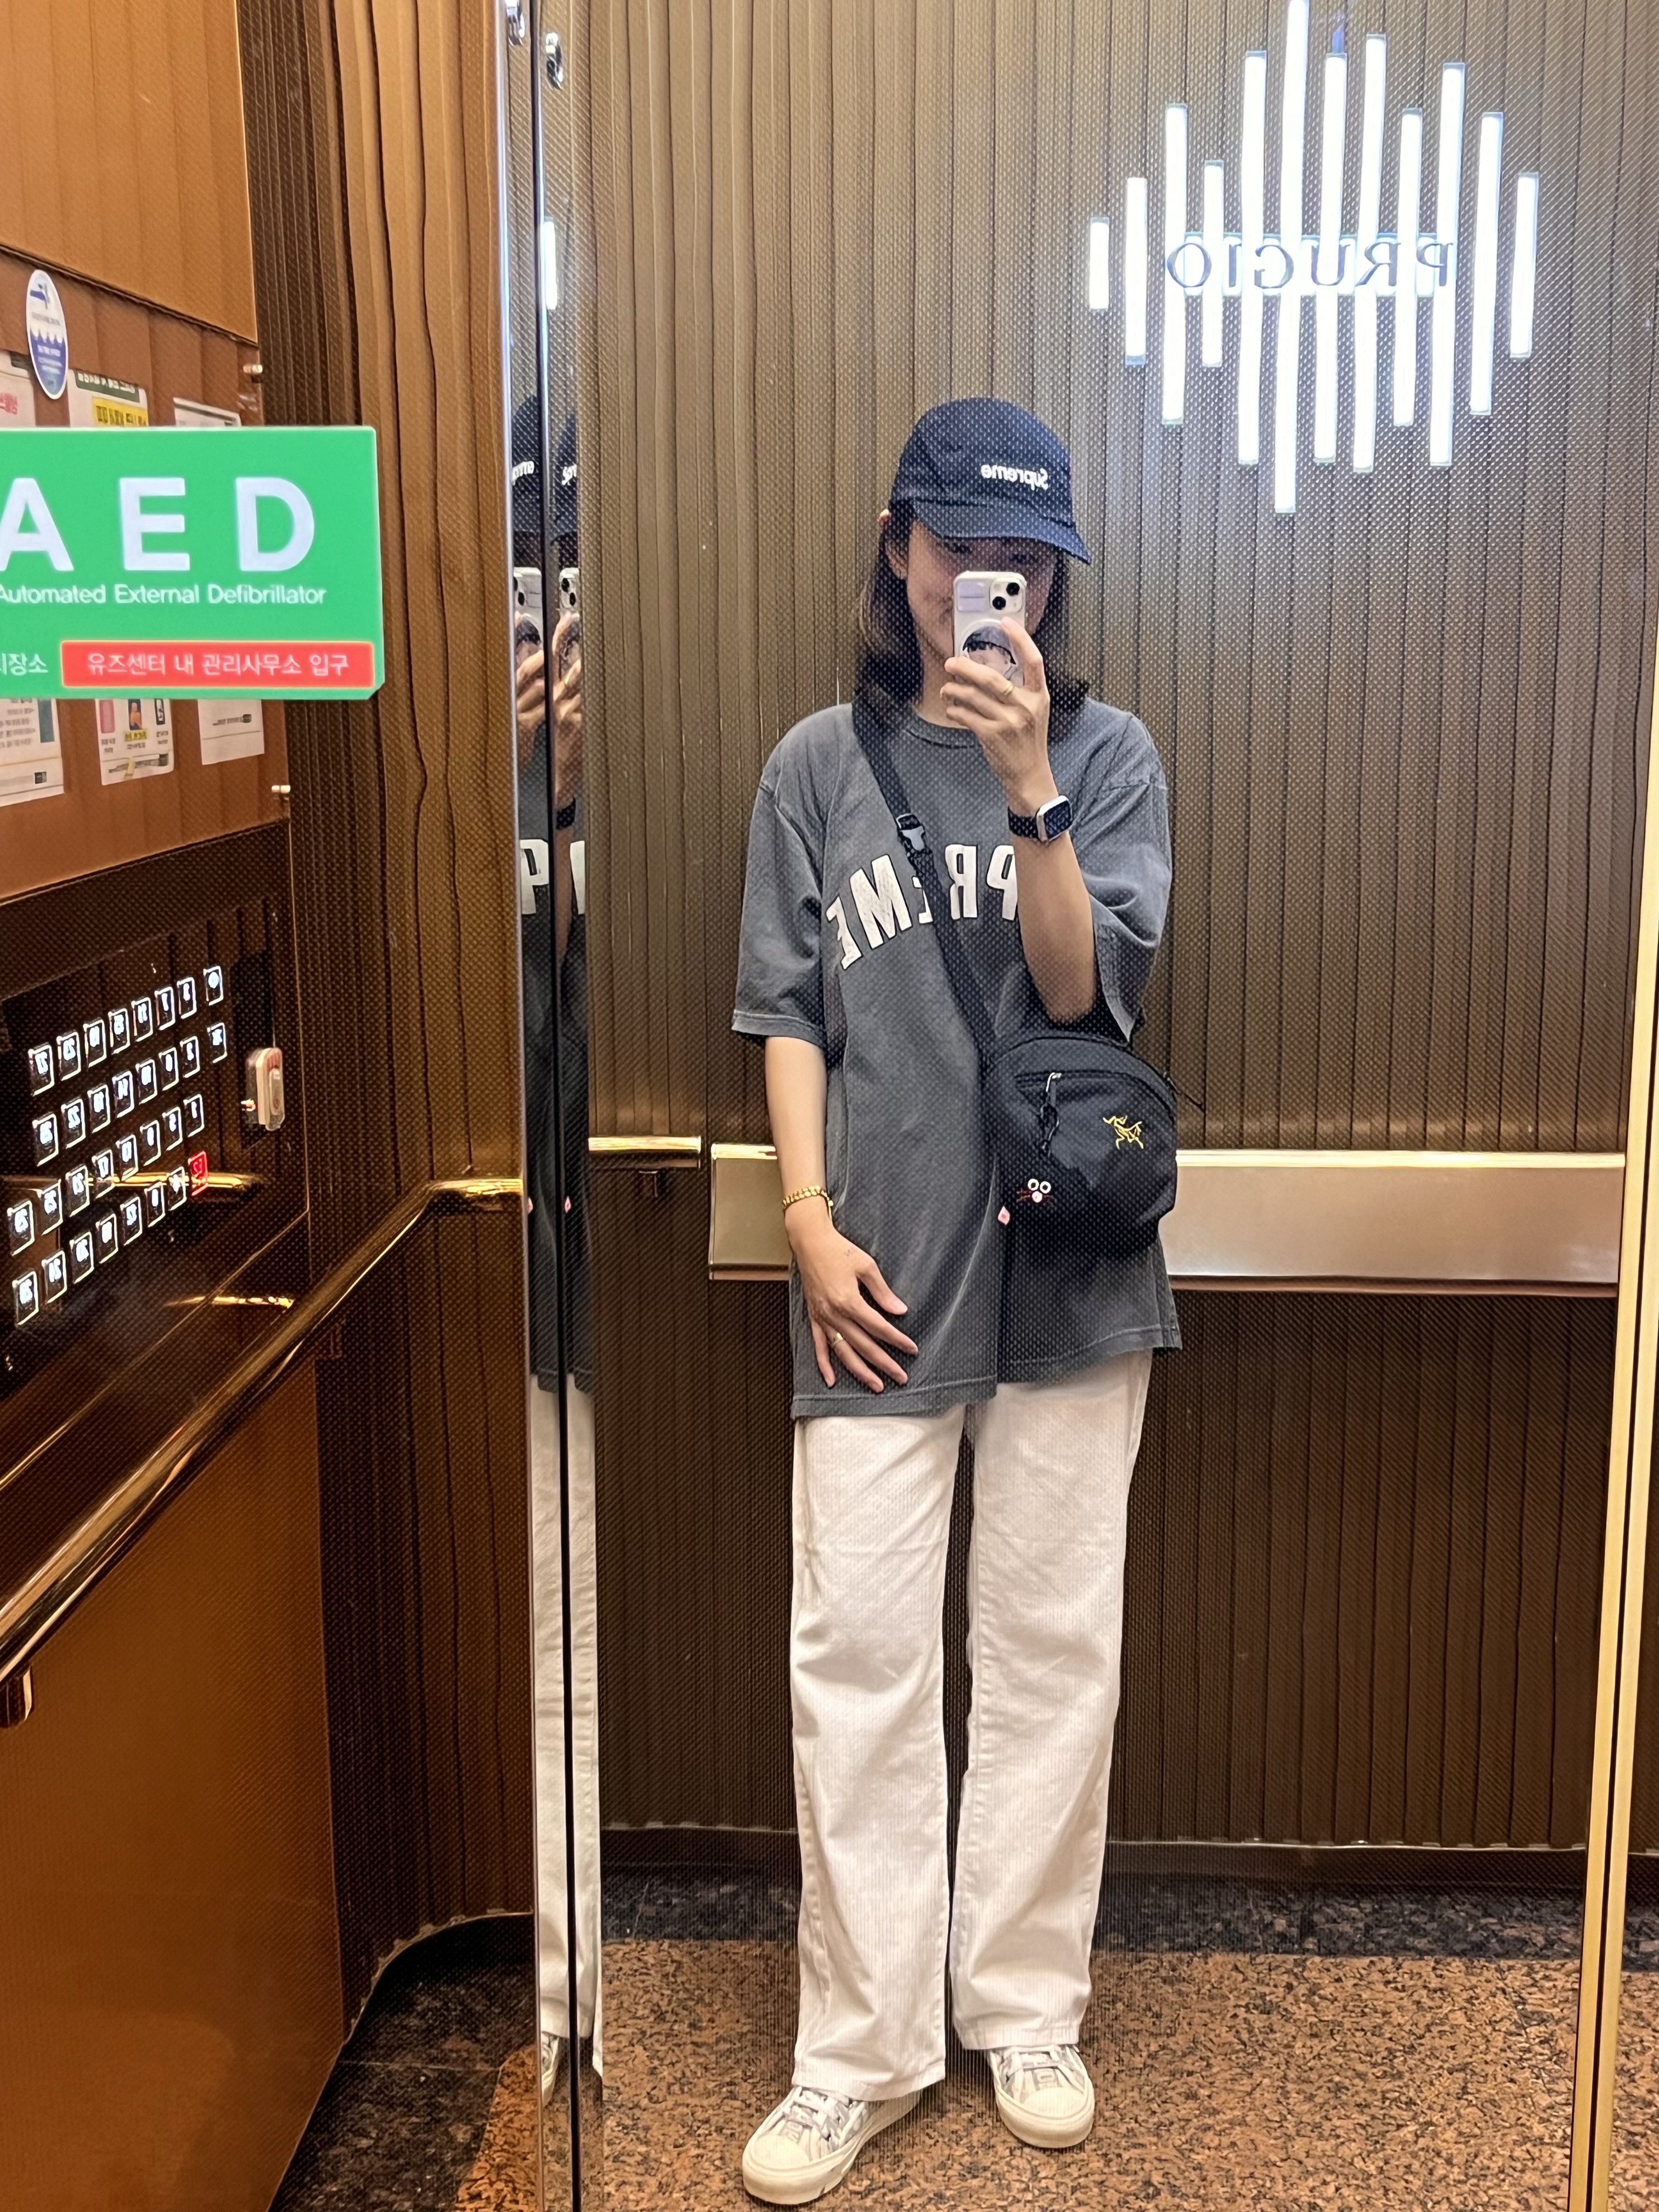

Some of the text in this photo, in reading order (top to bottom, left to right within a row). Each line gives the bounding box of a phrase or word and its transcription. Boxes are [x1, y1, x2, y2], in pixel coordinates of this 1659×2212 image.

[0, 583, 327, 604] Automated External Defibrillator
[87, 652, 349, 676] 유즈센터 내 관리사무소 입구
